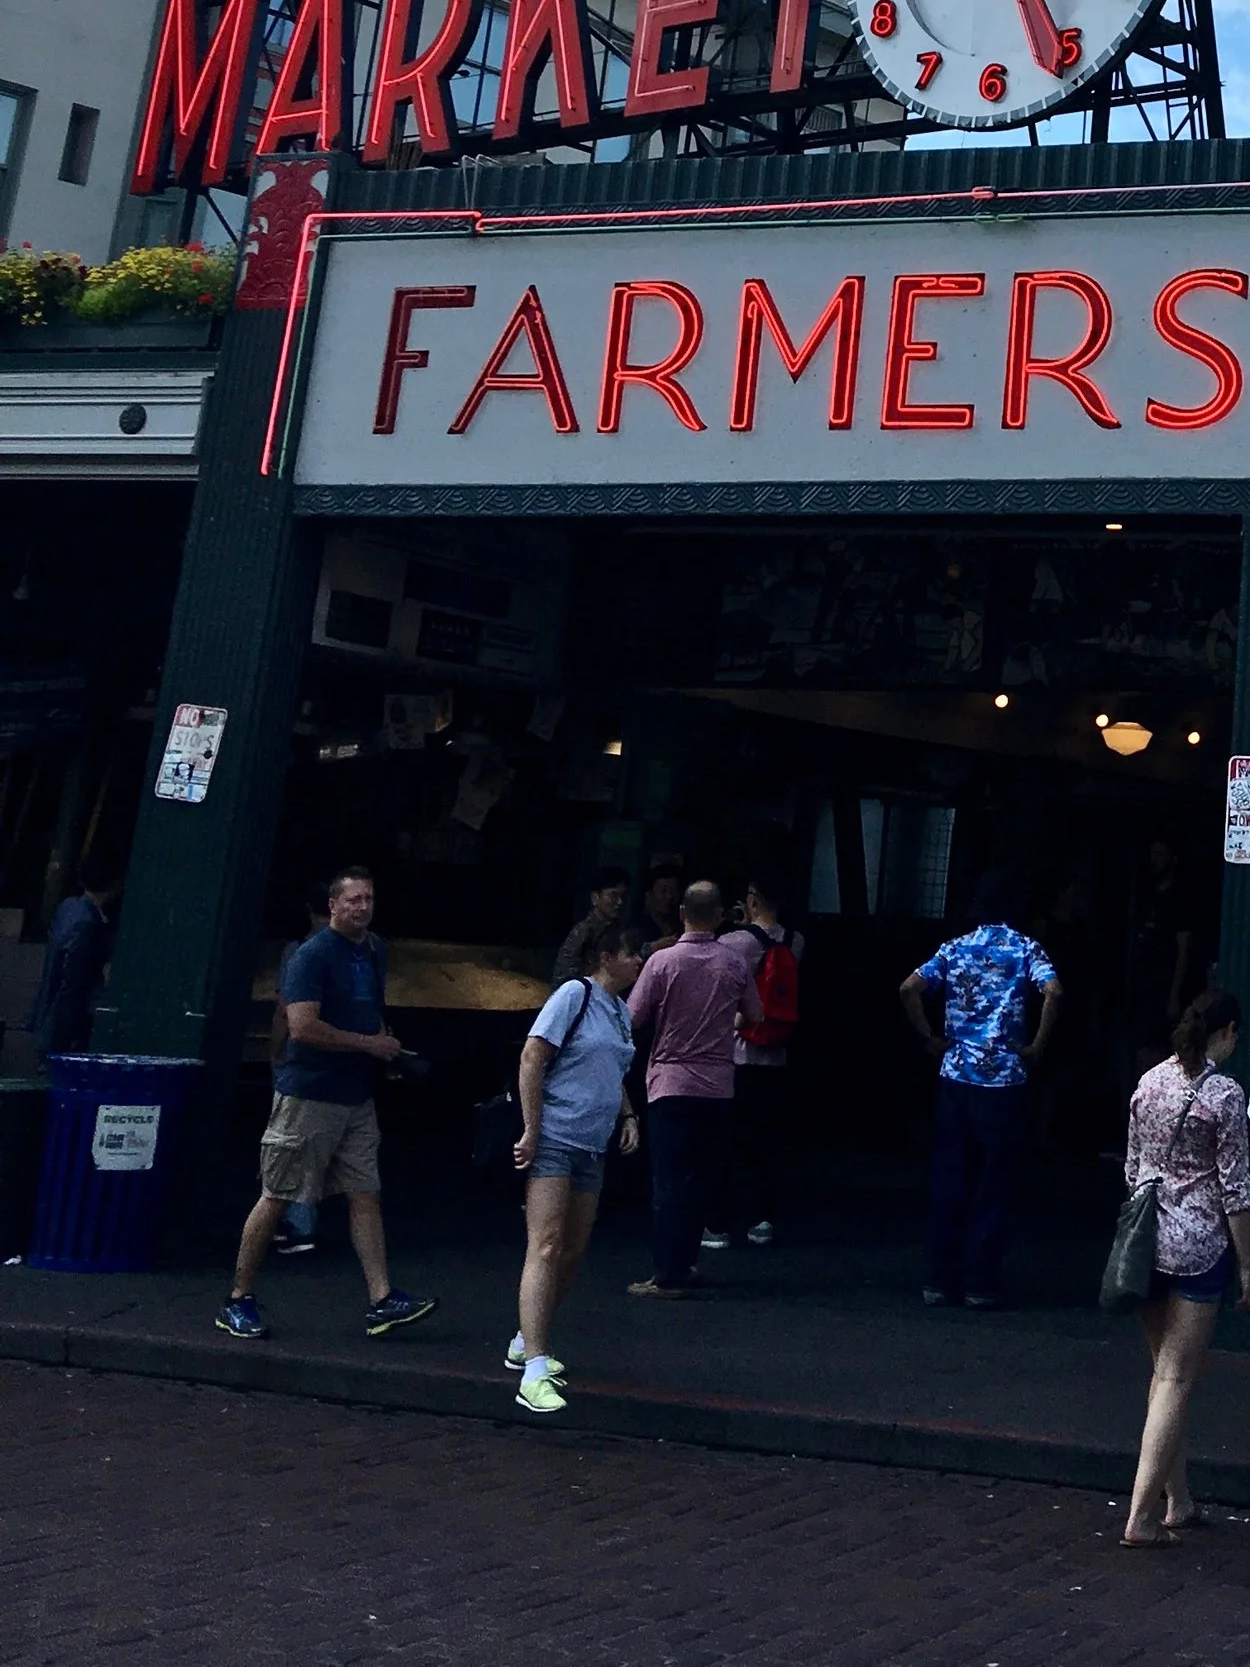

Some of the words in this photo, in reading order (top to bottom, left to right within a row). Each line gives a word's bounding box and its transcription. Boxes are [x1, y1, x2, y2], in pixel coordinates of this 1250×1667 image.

[1057, 27, 1083, 69] 5
[916, 51, 942, 90] 7
[979, 63, 1008, 102] 6
[372, 268, 1250, 435] FARMERS
[180, 707, 200, 726] NO
